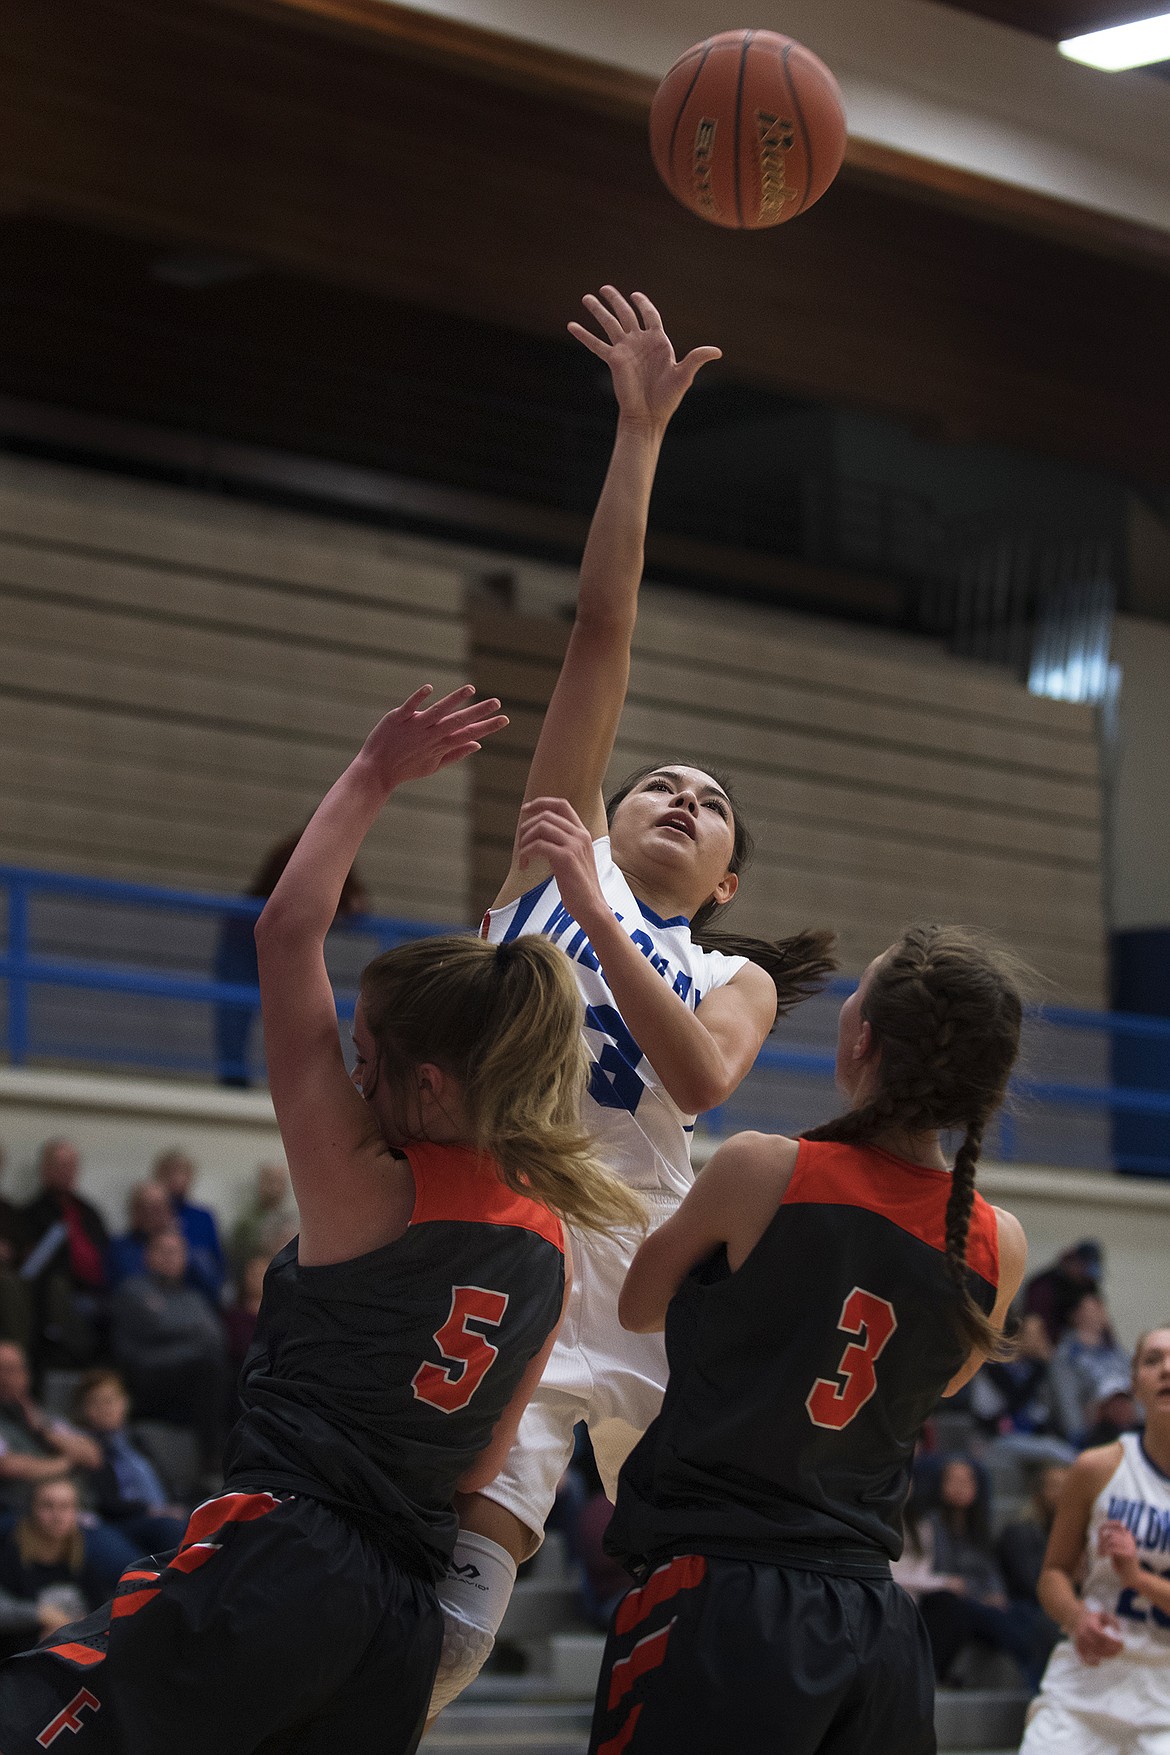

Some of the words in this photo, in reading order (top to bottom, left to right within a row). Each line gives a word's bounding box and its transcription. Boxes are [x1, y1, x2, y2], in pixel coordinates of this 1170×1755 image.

[412, 1287, 509, 1413] 5
[806, 1286, 897, 1430] 3
[36, 1687, 101, 1749] F
